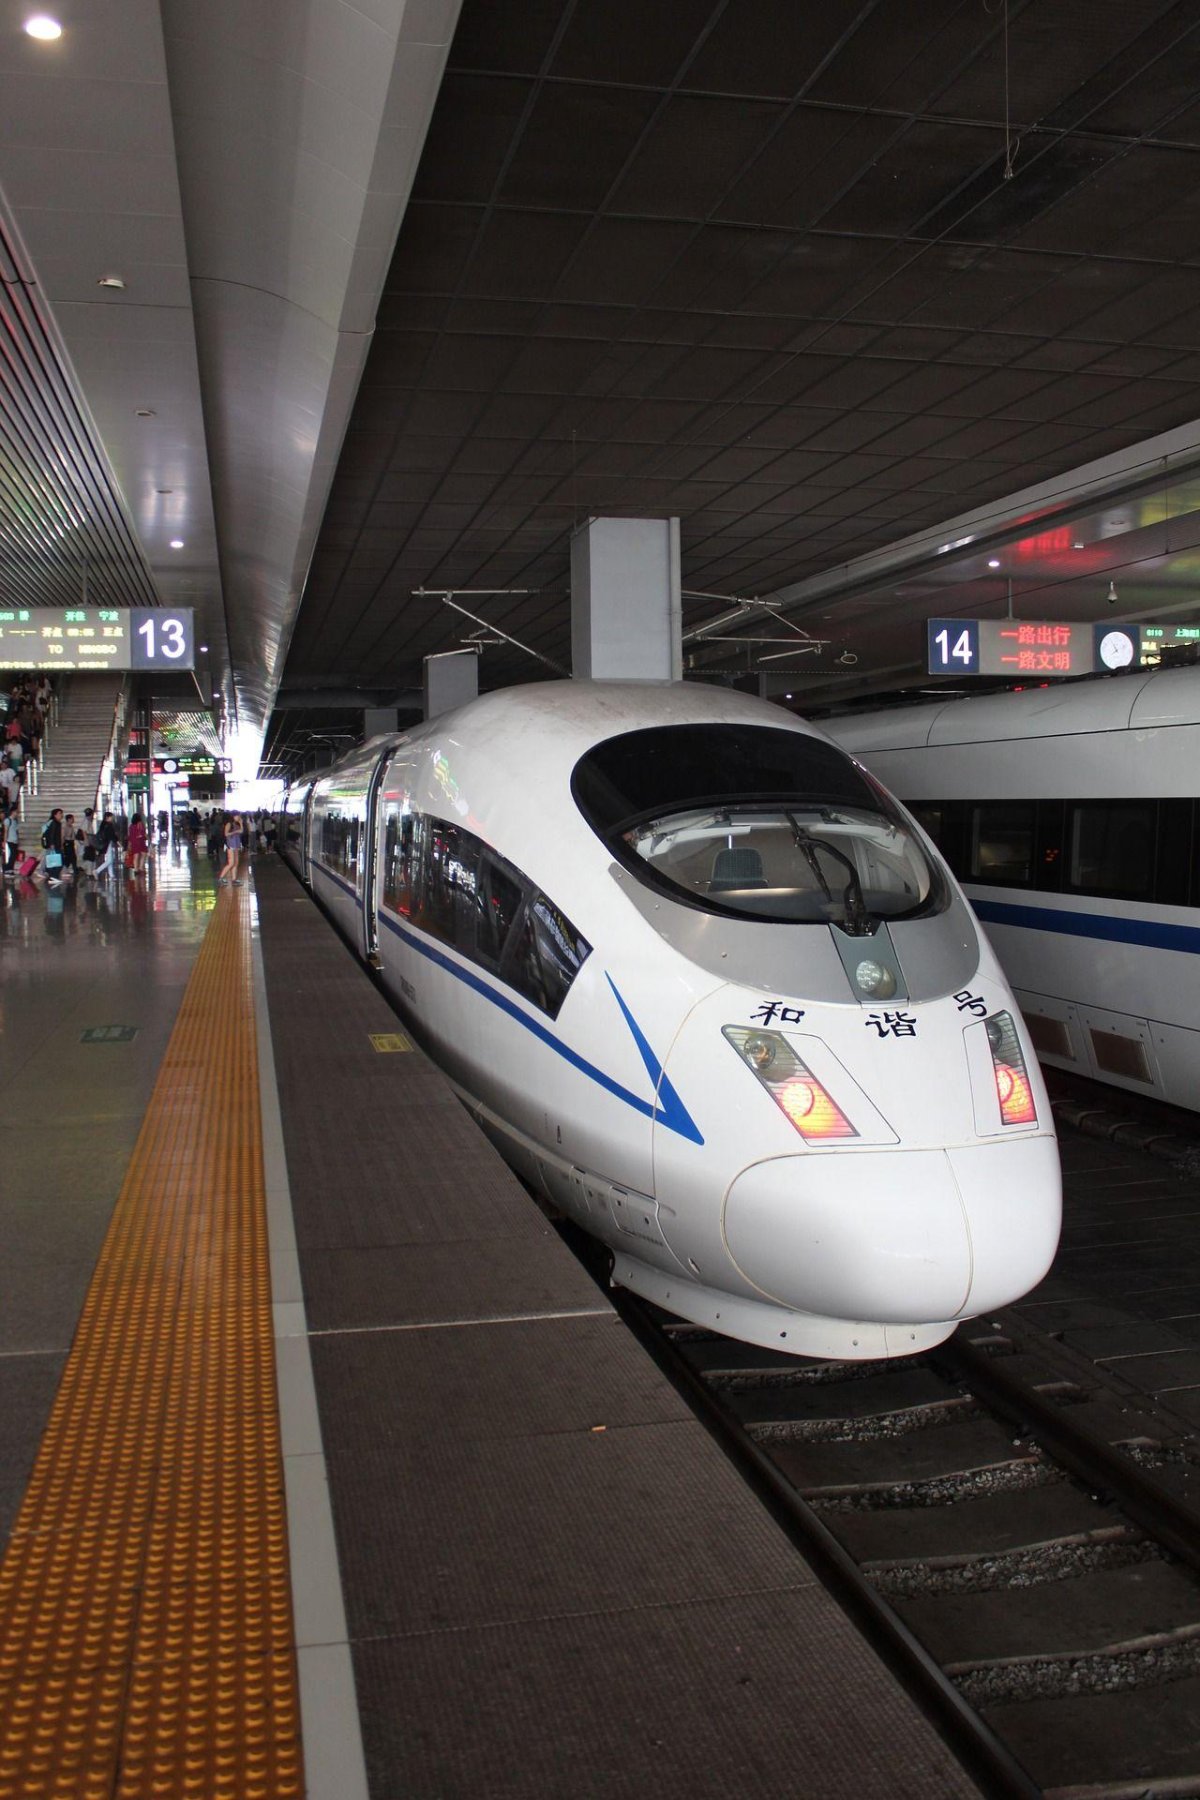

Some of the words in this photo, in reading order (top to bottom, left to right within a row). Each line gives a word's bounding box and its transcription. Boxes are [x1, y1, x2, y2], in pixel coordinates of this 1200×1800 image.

[138, 618, 186, 659] 13
[1000, 626, 1071, 646] 一路出行
[48, 644, 64, 654] TO
[935, 629, 973, 665] 14
[1000, 651, 1071, 670] 一路文明
[217, 760, 232, 772] 13
[749, 989, 988, 1039] 和谐号
